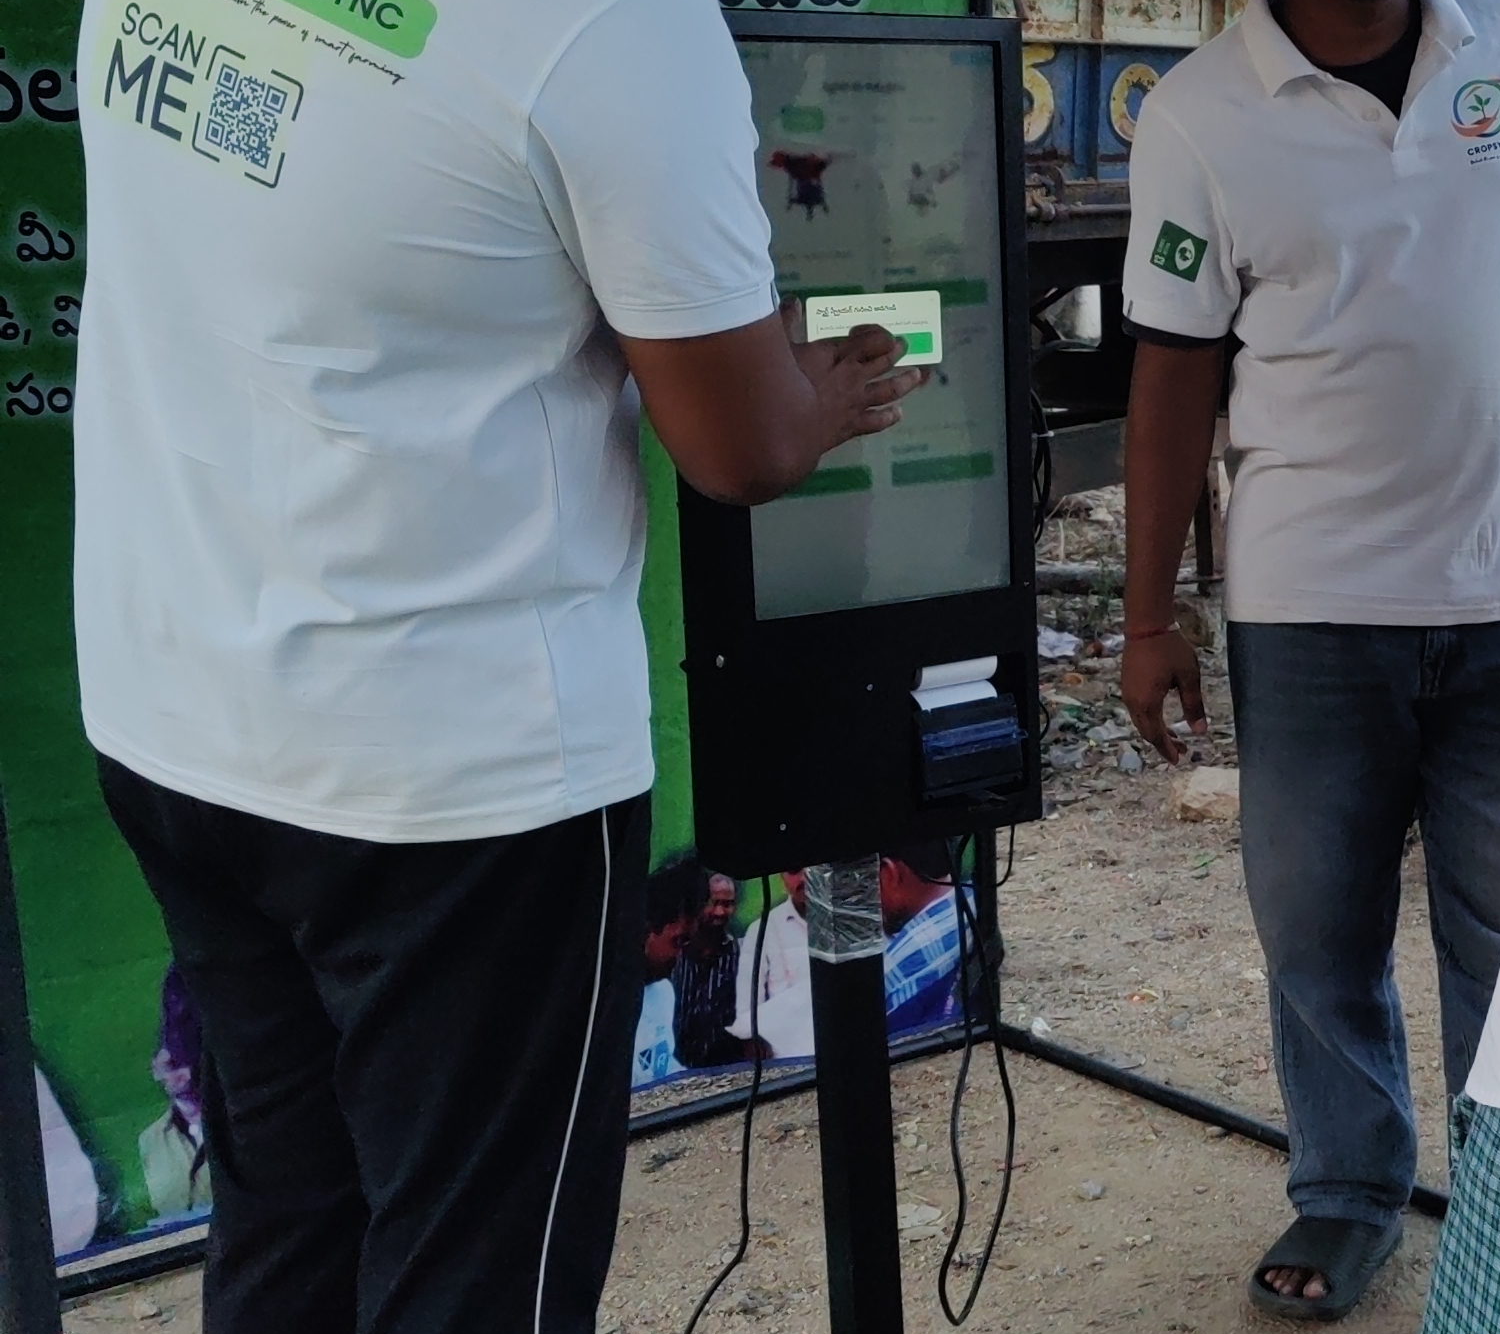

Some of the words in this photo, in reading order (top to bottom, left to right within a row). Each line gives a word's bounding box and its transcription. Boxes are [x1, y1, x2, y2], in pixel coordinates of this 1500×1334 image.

[121, 2, 206, 68] SCAN
[103, 37, 195, 142] ME
[348, 51, 406, 86] farming
